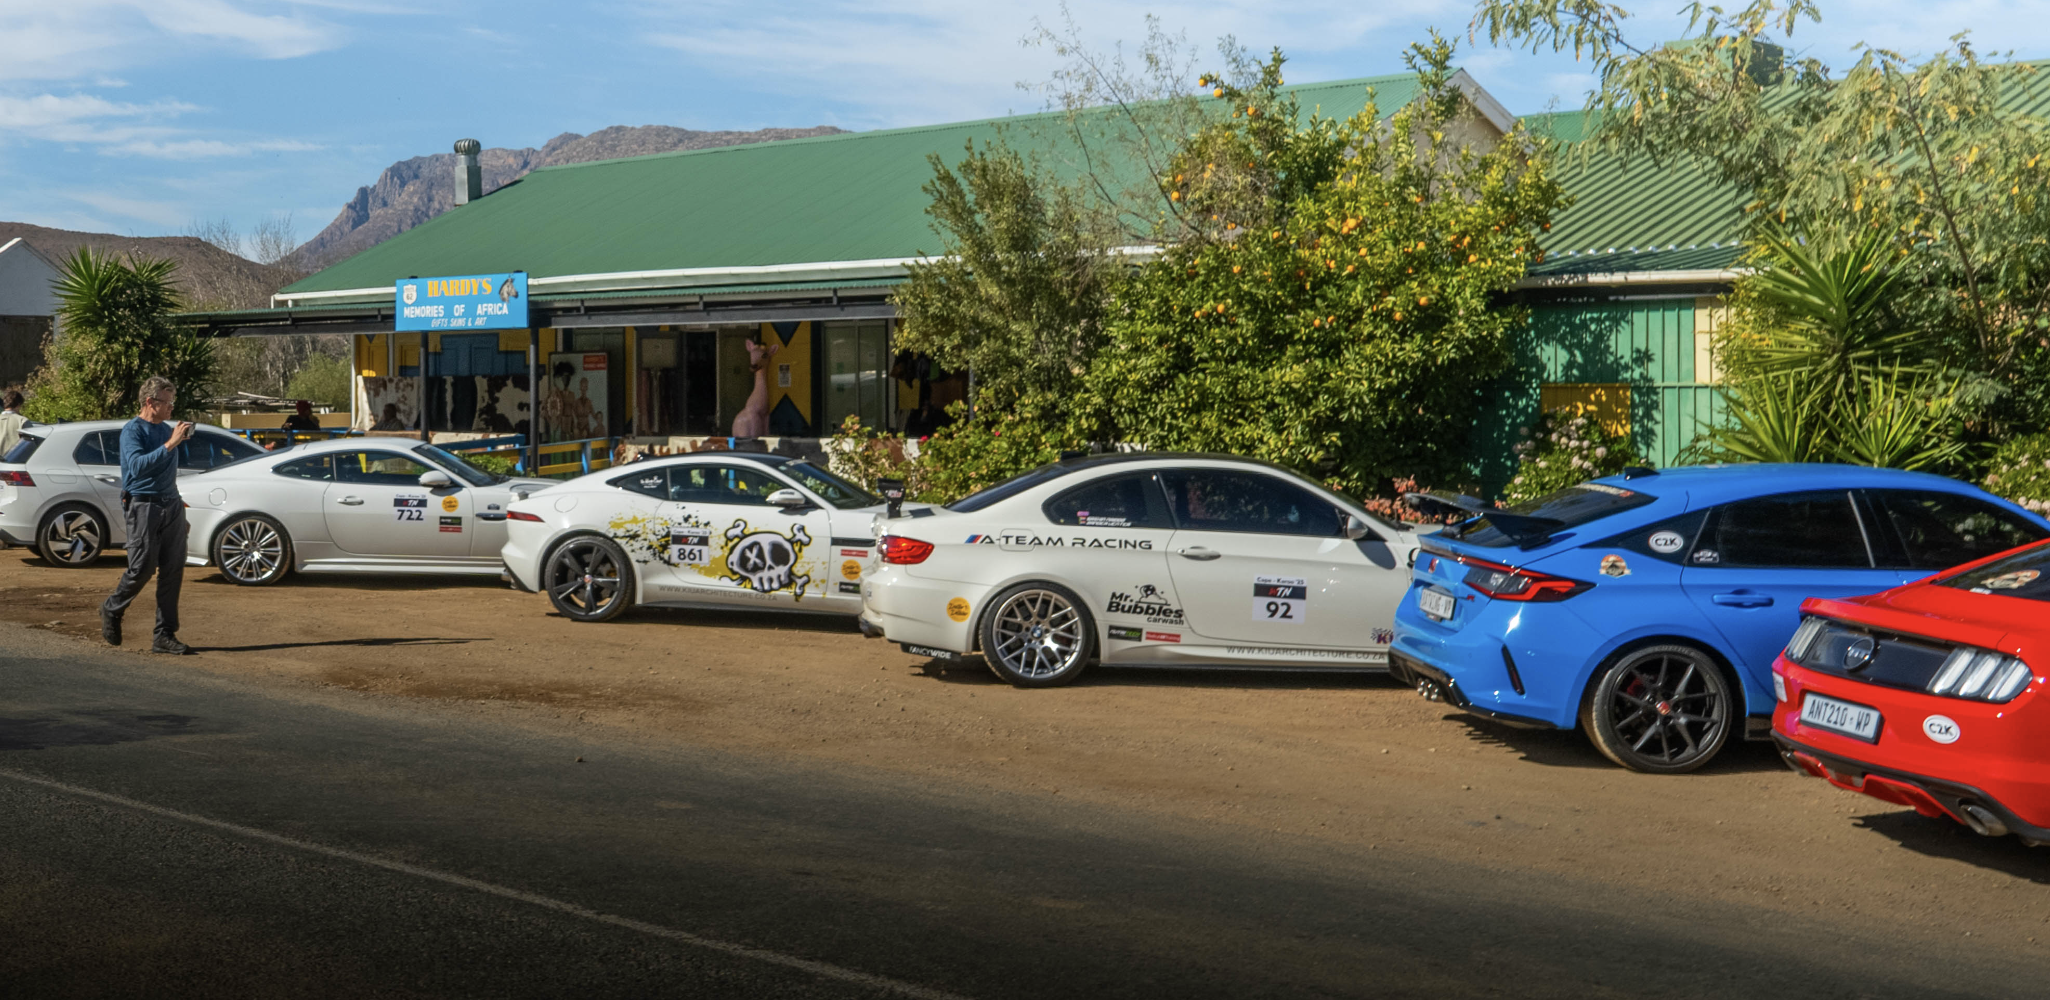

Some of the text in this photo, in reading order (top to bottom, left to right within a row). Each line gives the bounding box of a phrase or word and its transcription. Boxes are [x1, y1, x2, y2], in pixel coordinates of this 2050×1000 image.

[427, 278, 492, 297] HARDY'S
[404, 303, 508, 318] MEMORIES OF AFRICA
[431, 318, 448, 327] GIFTS
[474, 317, 487, 326] ART
[397, 509, 424, 521] 722
[980, 534, 1153, 550] A-TEAM RACING
[1654, 537, 1678, 547] C2K
[677, 548, 703, 561] 861
[1110, 591, 1134, 603] Mr.
[1106, 601, 1184, 618] Bubbles
[1265, 601, 1293, 619] 92
[1146, 616, 1185, 626] carwash
[1808, 699, 1872, 733] ANT210 WP
[1928, 722, 1954, 737] C2K
